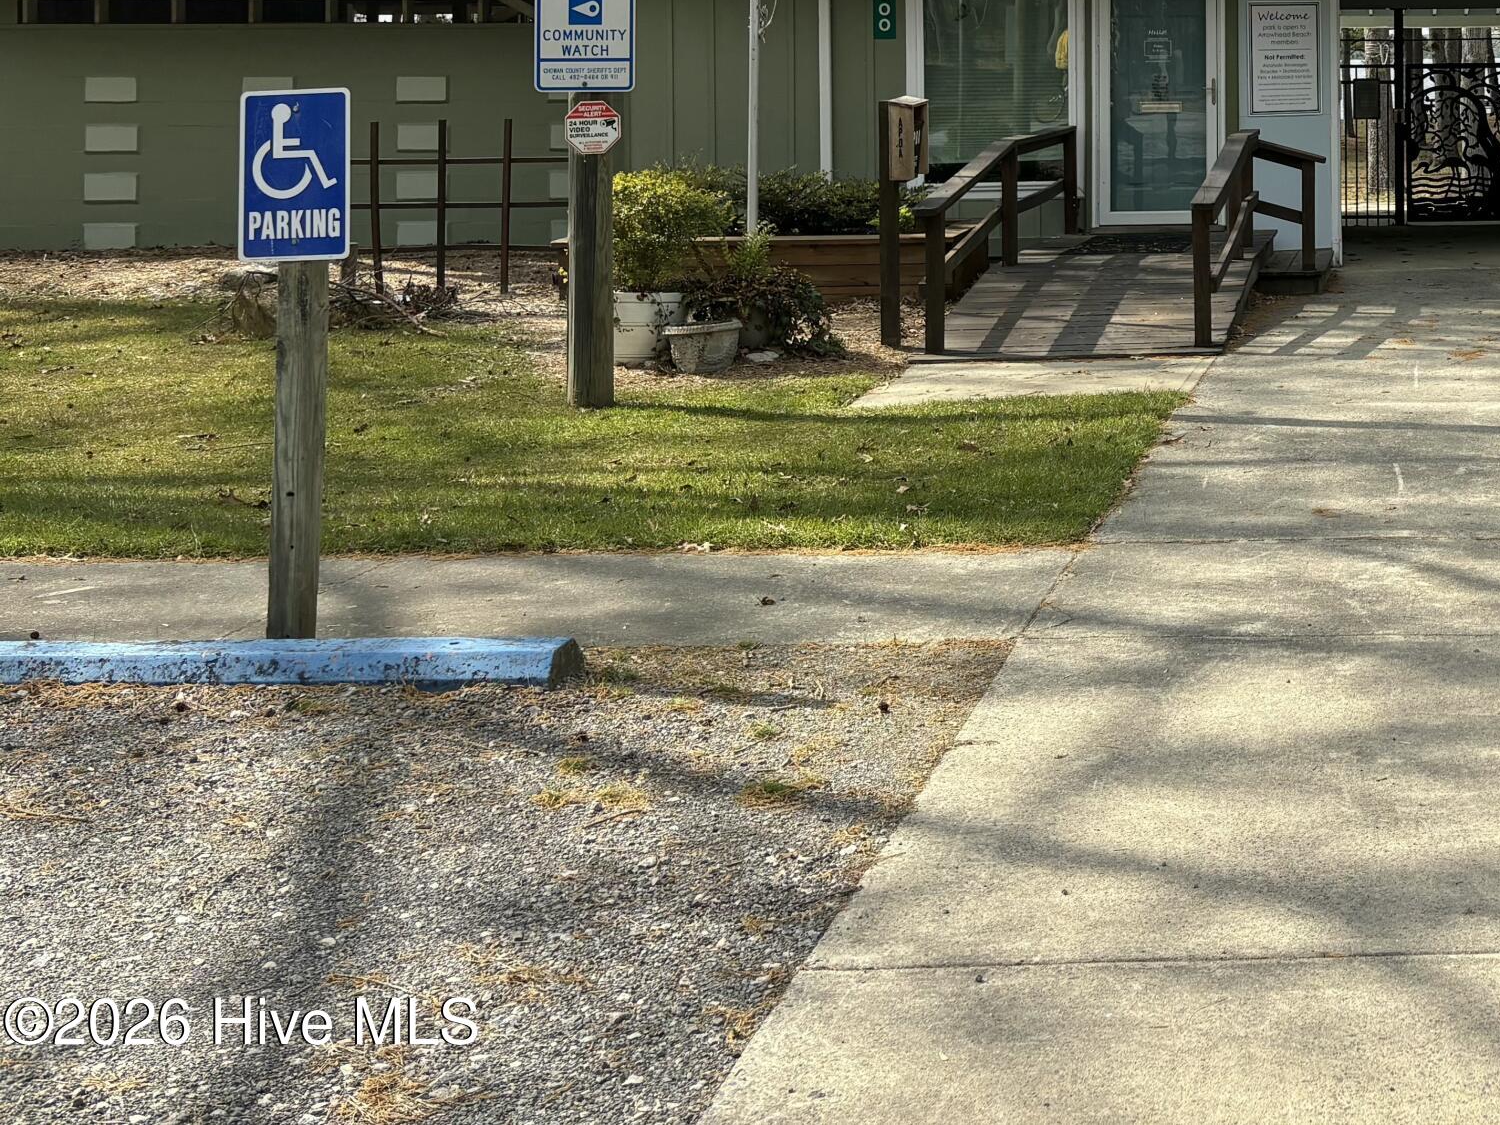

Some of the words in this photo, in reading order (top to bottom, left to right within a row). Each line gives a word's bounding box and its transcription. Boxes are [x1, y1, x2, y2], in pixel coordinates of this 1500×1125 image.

[1257, 10, 1310, 21] Welcome
[543, 29, 627, 42] COMMUNITY
[561, 44, 609, 57] WATCH
[248, 207, 341, 241] PARKING
